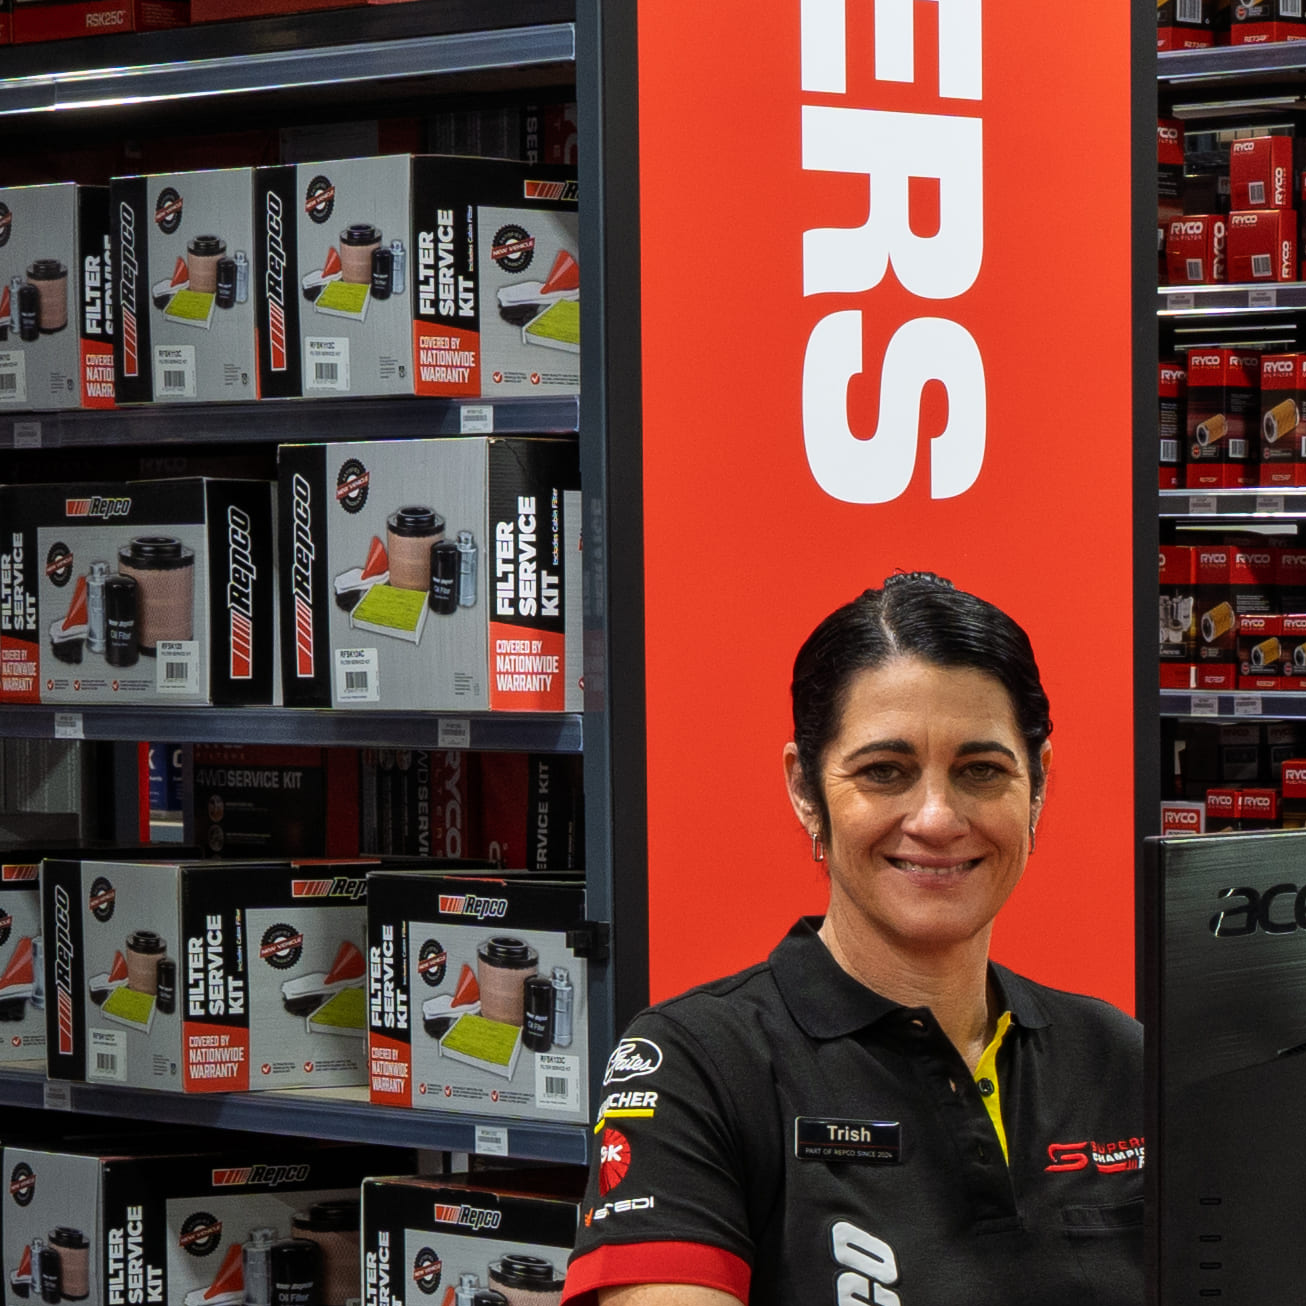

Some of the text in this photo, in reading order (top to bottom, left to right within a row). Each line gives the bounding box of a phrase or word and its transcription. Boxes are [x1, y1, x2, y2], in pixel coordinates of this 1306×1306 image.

[266, 191, 285, 305] Repco
[438, 209, 454, 316] SERVICE
[419, 232, 435, 314] FILTER
[459, 276, 474, 317] KIT
[420, 336, 460, 348] COVERED BY
[420, 351, 475, 367] NATIONWIDE
[420, 367, 470, 383] WARRANTY
[90, 496, 131, 519] Repco
[292, 473, 314, 604] Repco
[519, 496, 537, 617] SERVICE
[228, 505, 257, 618] Repco
[496, 521, 514, 616] FILTER
[541, 570, 559, 616] KIT
[496, 640, 542, 654] COVERED BY
[496, 655, 559, 673] NATIONWIDE
[496, 674, 552, 691] WARRANTY
[462, 895, 508, 919] Repco
[54, 884, 74, 983] Repco
[827, 1125, 871, 1142] Trish
[248, 1164, 309, 1185] Repco
[458, 1204, 501, 1230] Repco
[108, 1227, 124, 1305] FILTER
[127, 1205, 143, 1304] SERVICE
[146, 1265, 163, 1303] KIT
